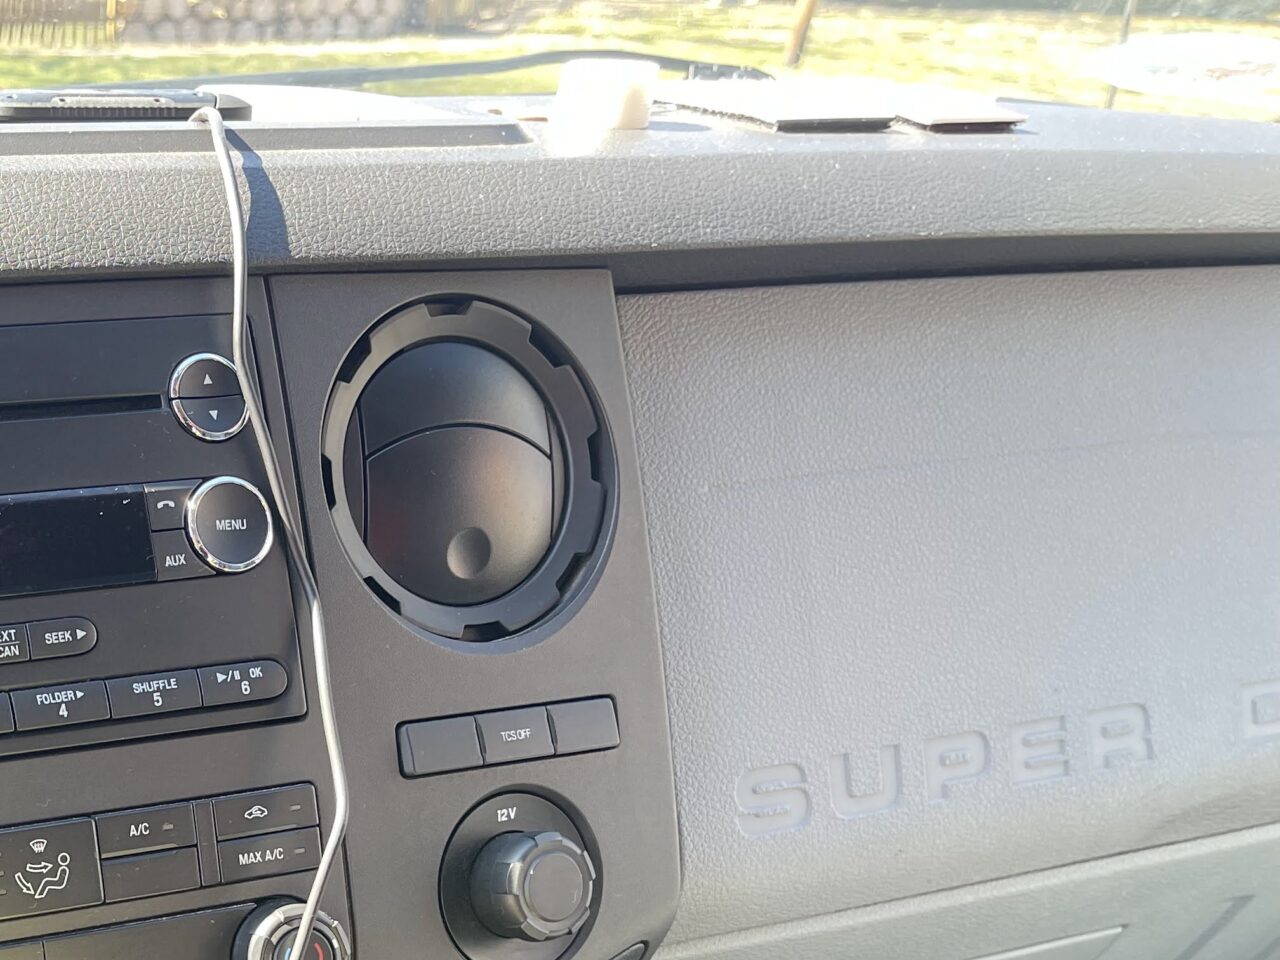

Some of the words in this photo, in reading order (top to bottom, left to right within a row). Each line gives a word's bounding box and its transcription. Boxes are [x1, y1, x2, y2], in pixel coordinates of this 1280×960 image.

[215, 519, 247, 531] MENU
[165, 554, 186, 567] AUX
[44, 631, 73, 644] SEEK
[249, 667, 263, 679] OK
[132, 678, 178, 693] SHUFFLE
[240, 681, 251, 695] 6
[36, 690, 75, 705] FOLDER
[153, 691, 163, 707] 5
[58, 703, 69, 718] 4
[500, 730, 517, 741] TCS
[517, 728, 531, 740] OFF
[733, 702, 1156, 840] SUPER
[496, 806, 517, 822] 12V
[129, 822, 151, 837] A/C
[238, 853, 262, 866] MAX
[265, 847, 285, 862] A/C
